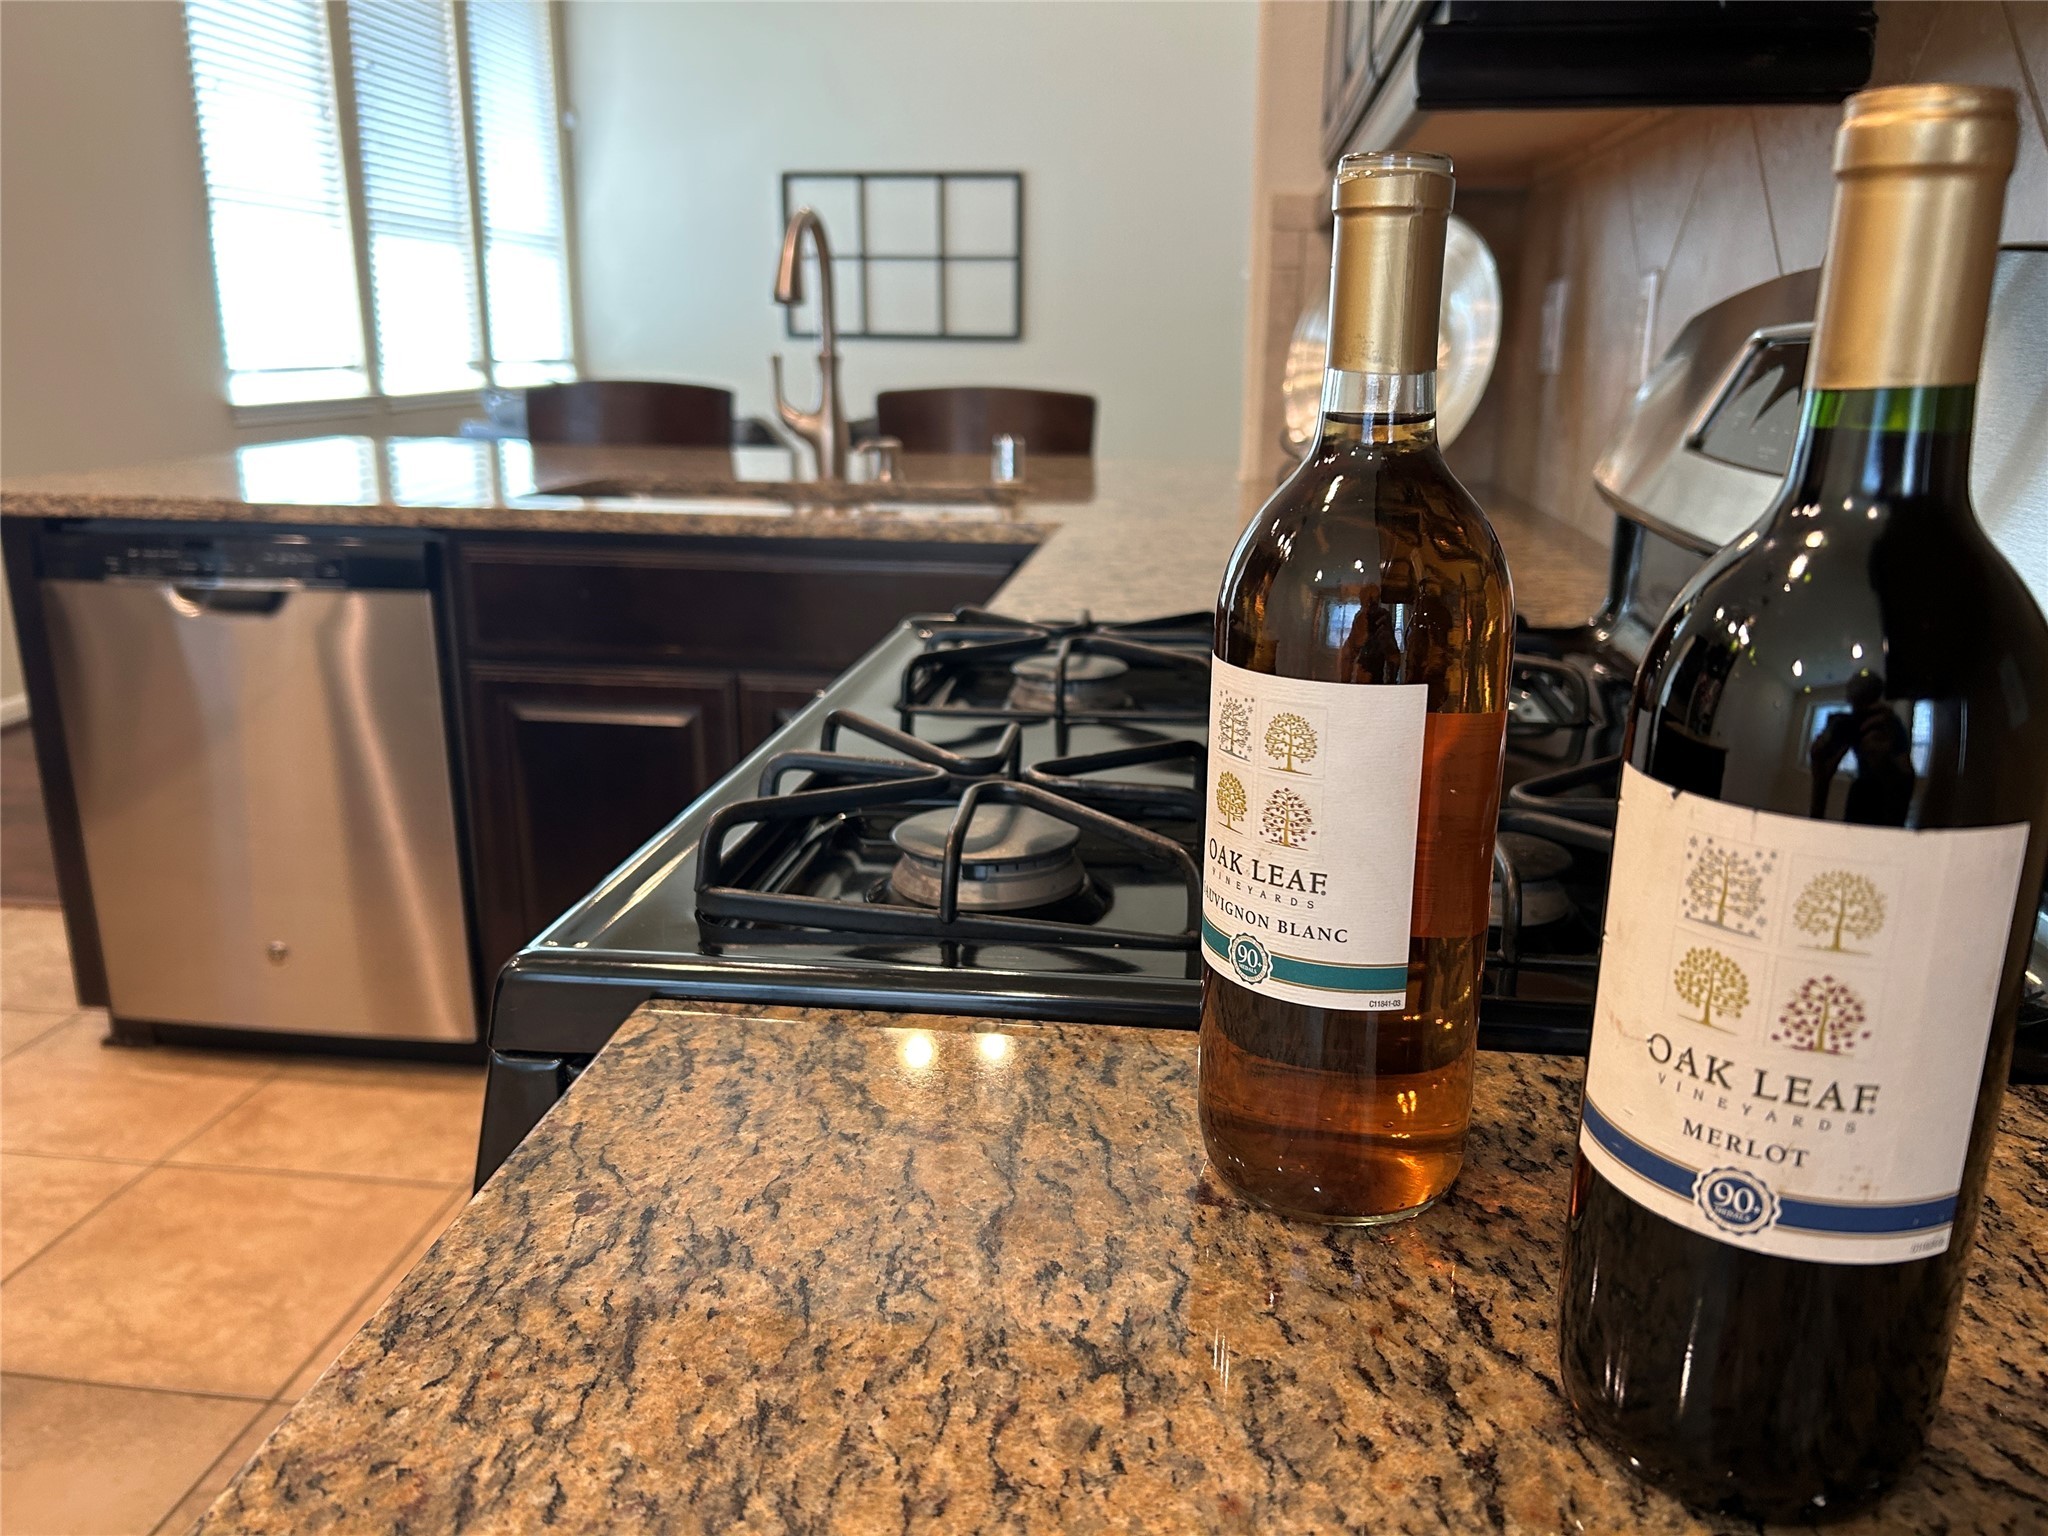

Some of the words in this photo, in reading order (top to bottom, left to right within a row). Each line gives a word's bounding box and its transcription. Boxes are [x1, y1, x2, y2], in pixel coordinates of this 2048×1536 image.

[1209, 838, 1243, 875] OAK
[1212, 866, 1315, 909] VINEYARDS
[1277, 919, 1348, 943] BLANC
[1368, 1000, 1401, 1008] C11841-03
[1646, 1033, 1735, 1091] OAK
[1657, 1072, 1857, 1134] VINEYARDS
[1682, 1117, 1810, 1168] MERLOT
